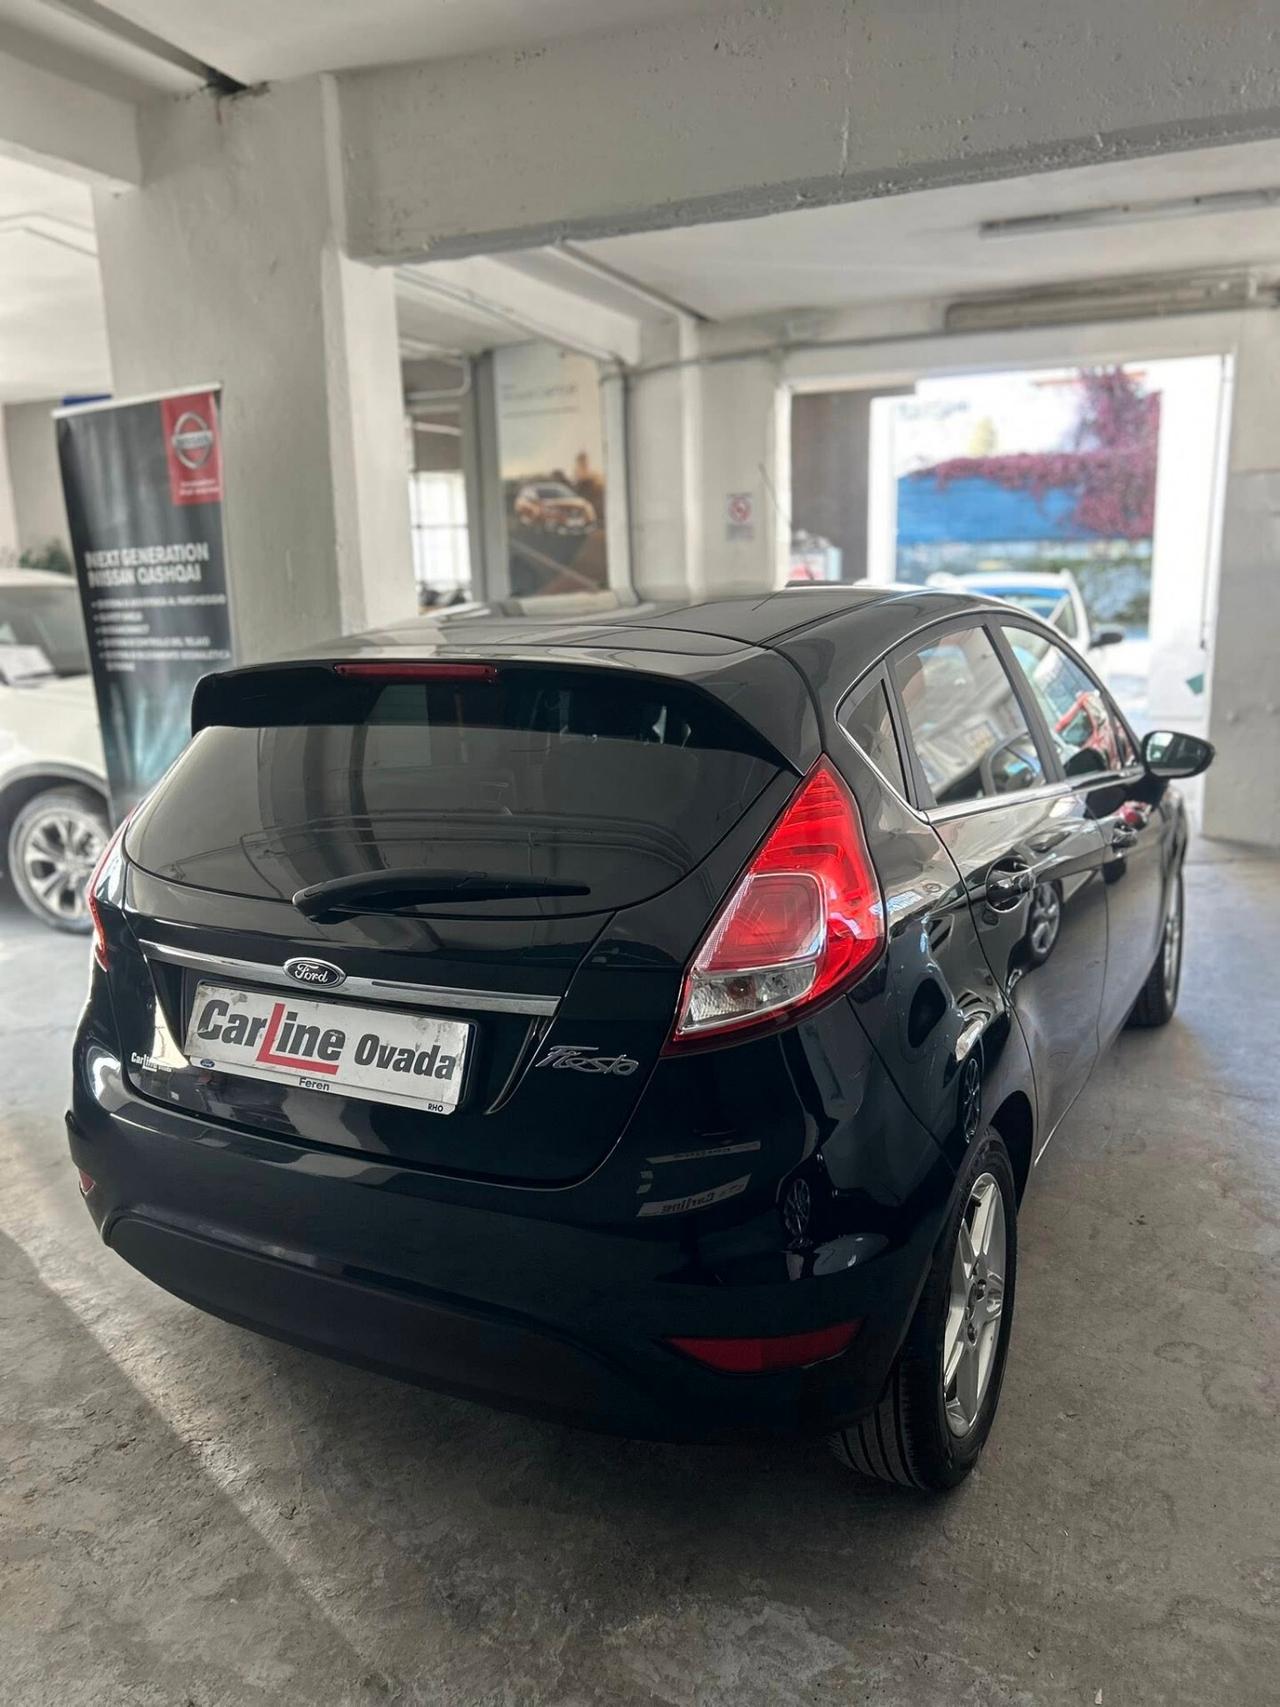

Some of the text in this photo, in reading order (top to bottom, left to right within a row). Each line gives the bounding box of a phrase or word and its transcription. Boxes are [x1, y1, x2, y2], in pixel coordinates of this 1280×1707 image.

[121, 542, 209, 566] GENERATION
[294, 963, 328, 983] Ford
[354, 1033, 457, 1080] Ovada
[298, 1077, 330, 1092] Feren
[427, 1103, 444, 1112] RHO
